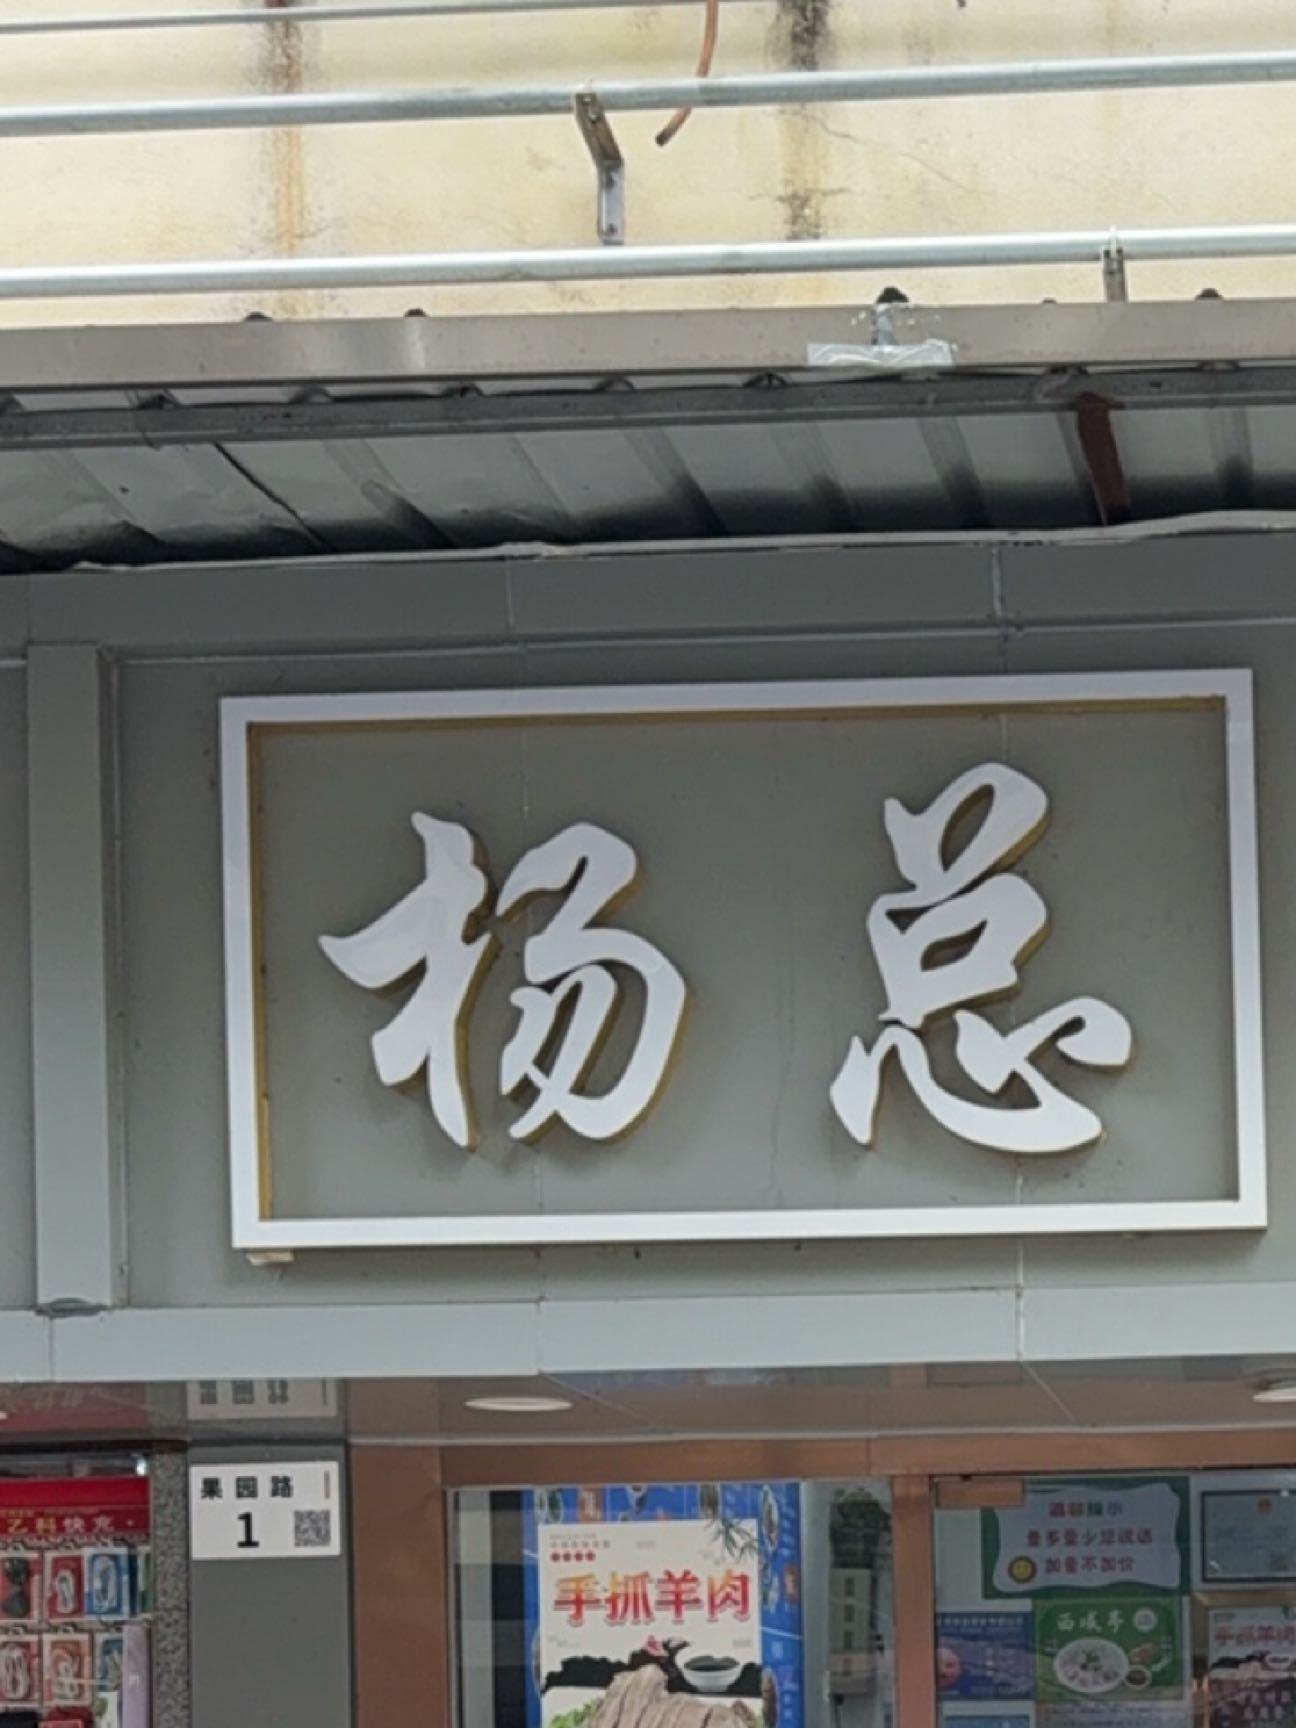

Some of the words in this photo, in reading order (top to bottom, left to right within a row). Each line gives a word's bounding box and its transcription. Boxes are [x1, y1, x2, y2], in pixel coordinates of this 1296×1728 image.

[318, 761, 1134, 1153] 杨总
[200, 1475, 293, 1499] 果园路
[237, 1511, 259, 1548] 1
[552, 1567, 752, 1627] 手抓羊肉
